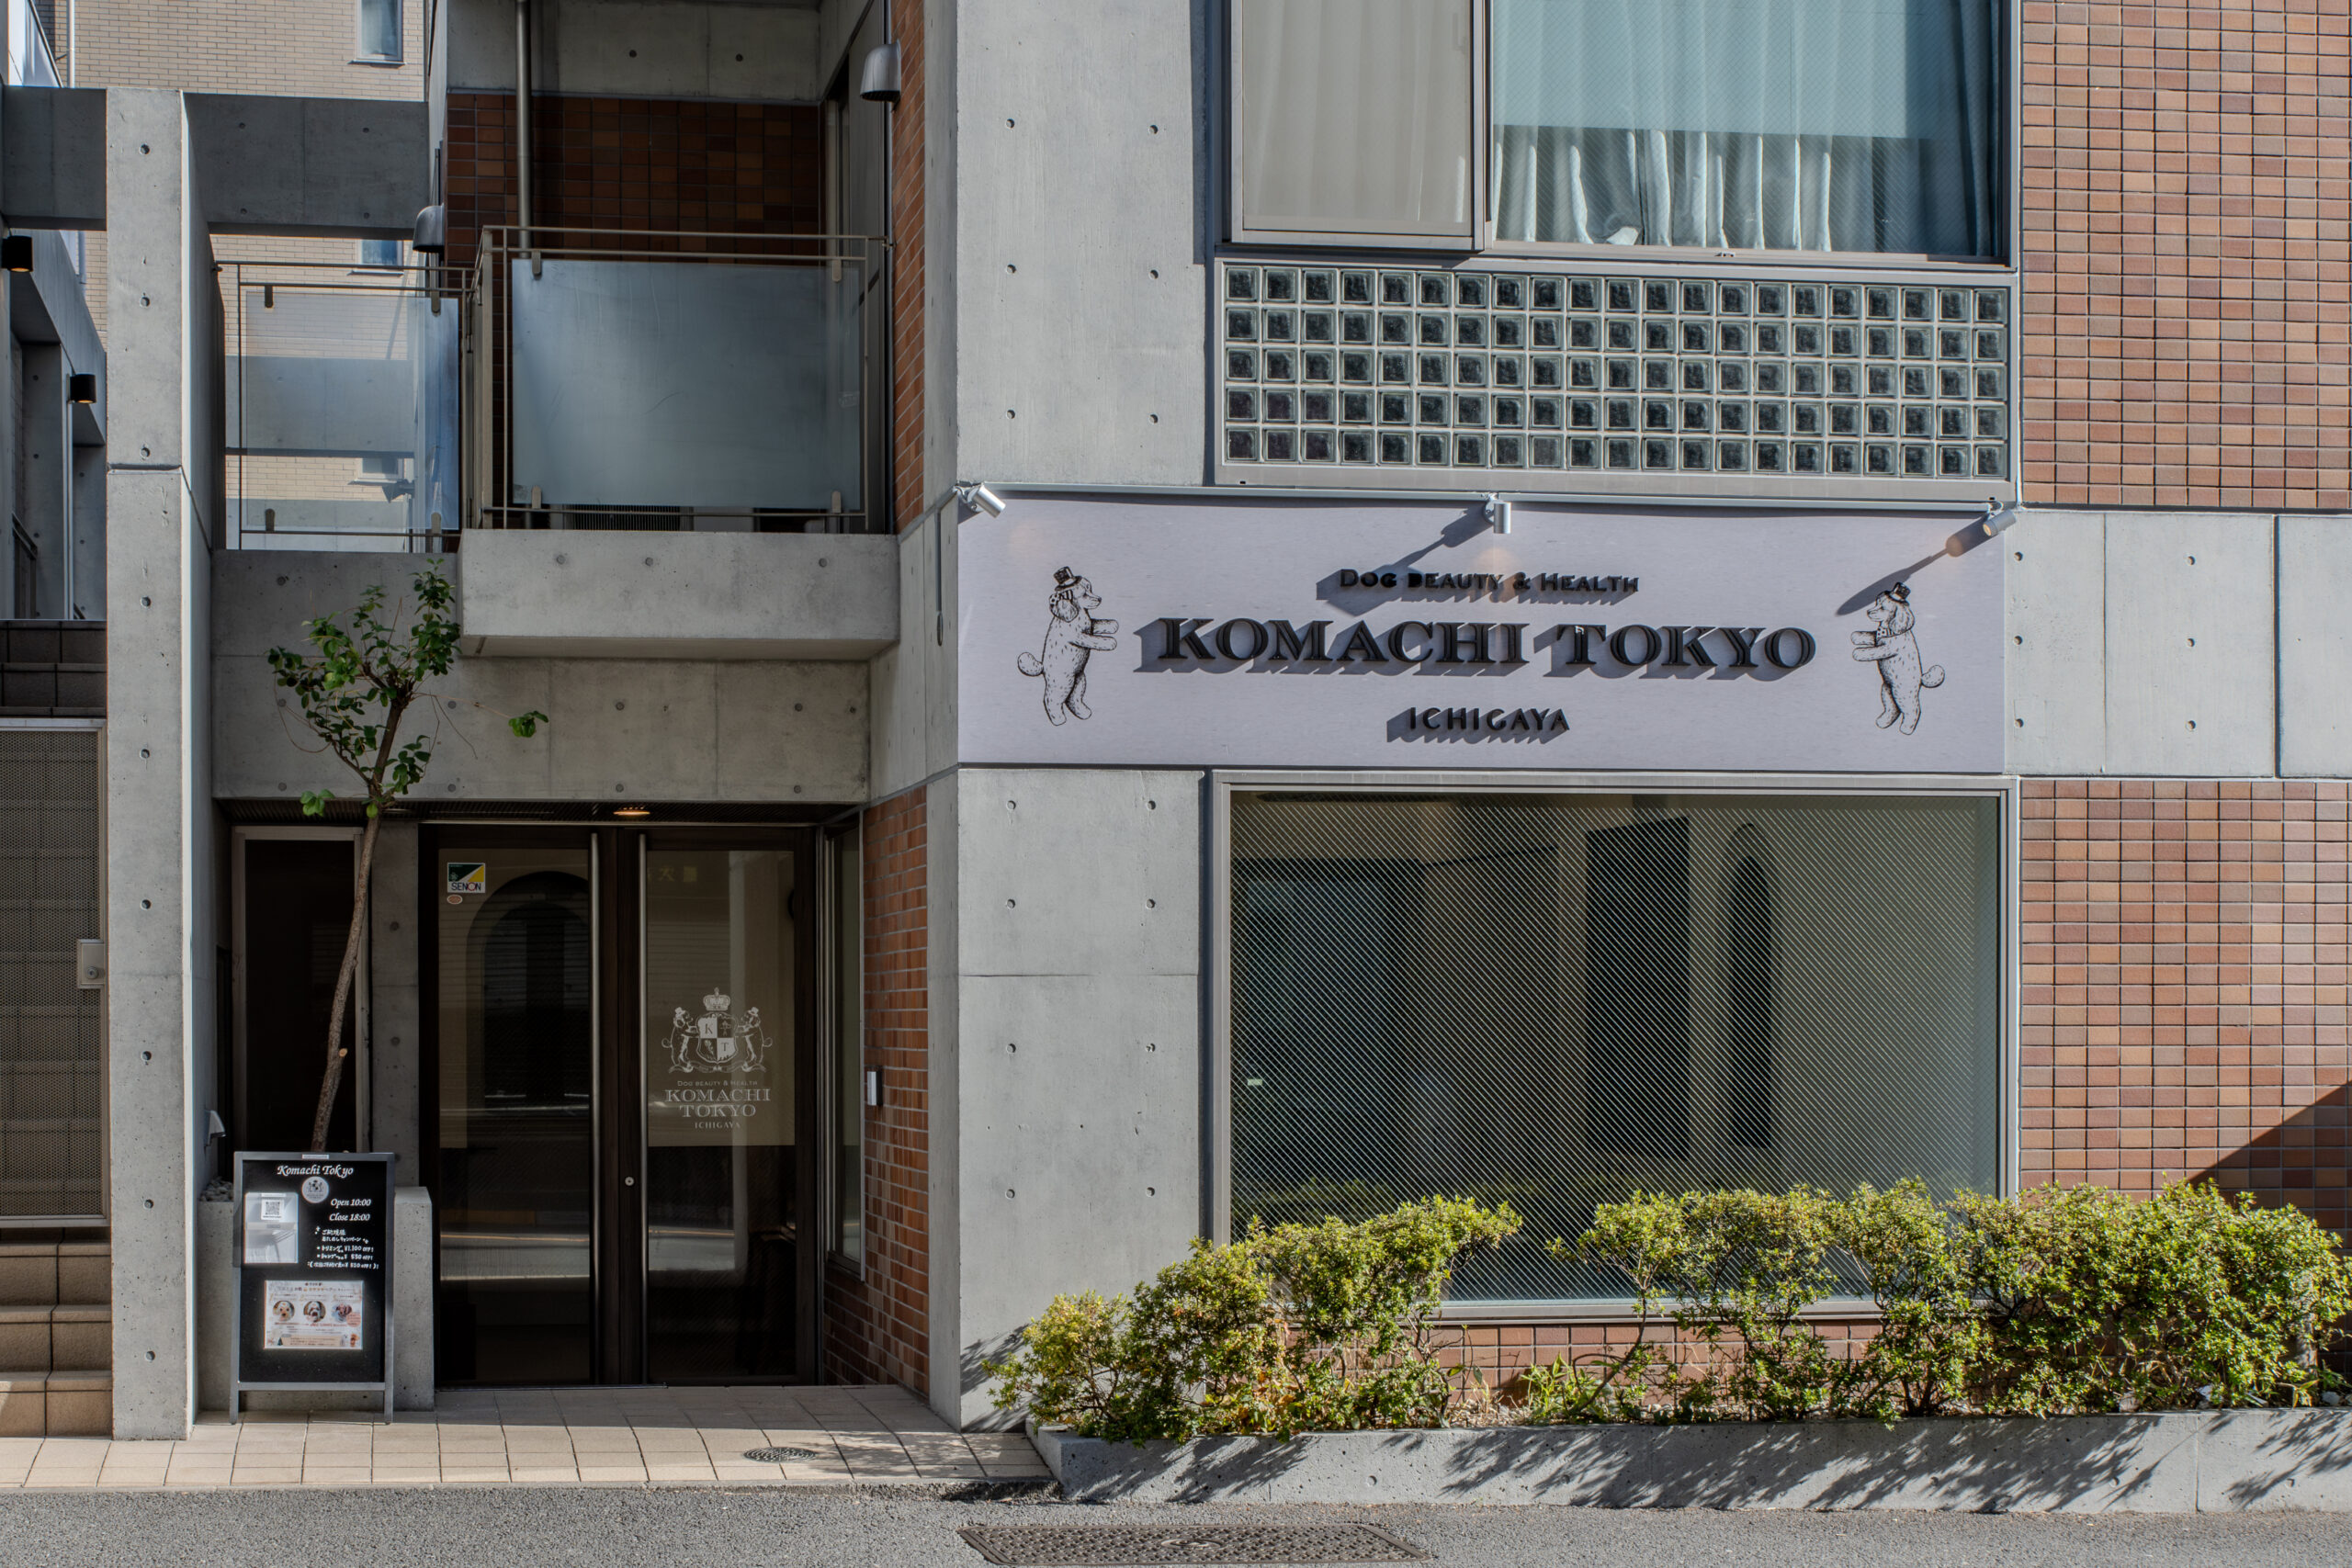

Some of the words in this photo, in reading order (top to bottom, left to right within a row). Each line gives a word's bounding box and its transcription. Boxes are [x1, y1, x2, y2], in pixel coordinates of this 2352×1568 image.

[1340, 569, 1397, 588] DOG
[1408, 572, 1503, 590] BEAUTY
[1512, 572, 1531, 590] &
[1541, 572, 1640, 592] HEALTH
[1158, 617, 1531, 664] KOMACHI
[1556, 624, 1816, 669] TOKYO
[1409, 706, 1570, 731] ICHIGAYA
[451, 882, 481, 891] SENON
[705, 1024, 713, 1034] K
[720, 1042, 729, 1052] T
[665, 1089, 771, 1102] KOMACHI
[679, 1104, 756, 1117] TOKYO
[277, 1165, 321, 1175] Komachi
[322, 1166, 354, 1179] Tokyo
[330, 1199, 349, 1208] Open
[329, 1213, 348, 1222] Close
[349, 1213, 370, 1222] 18:00
